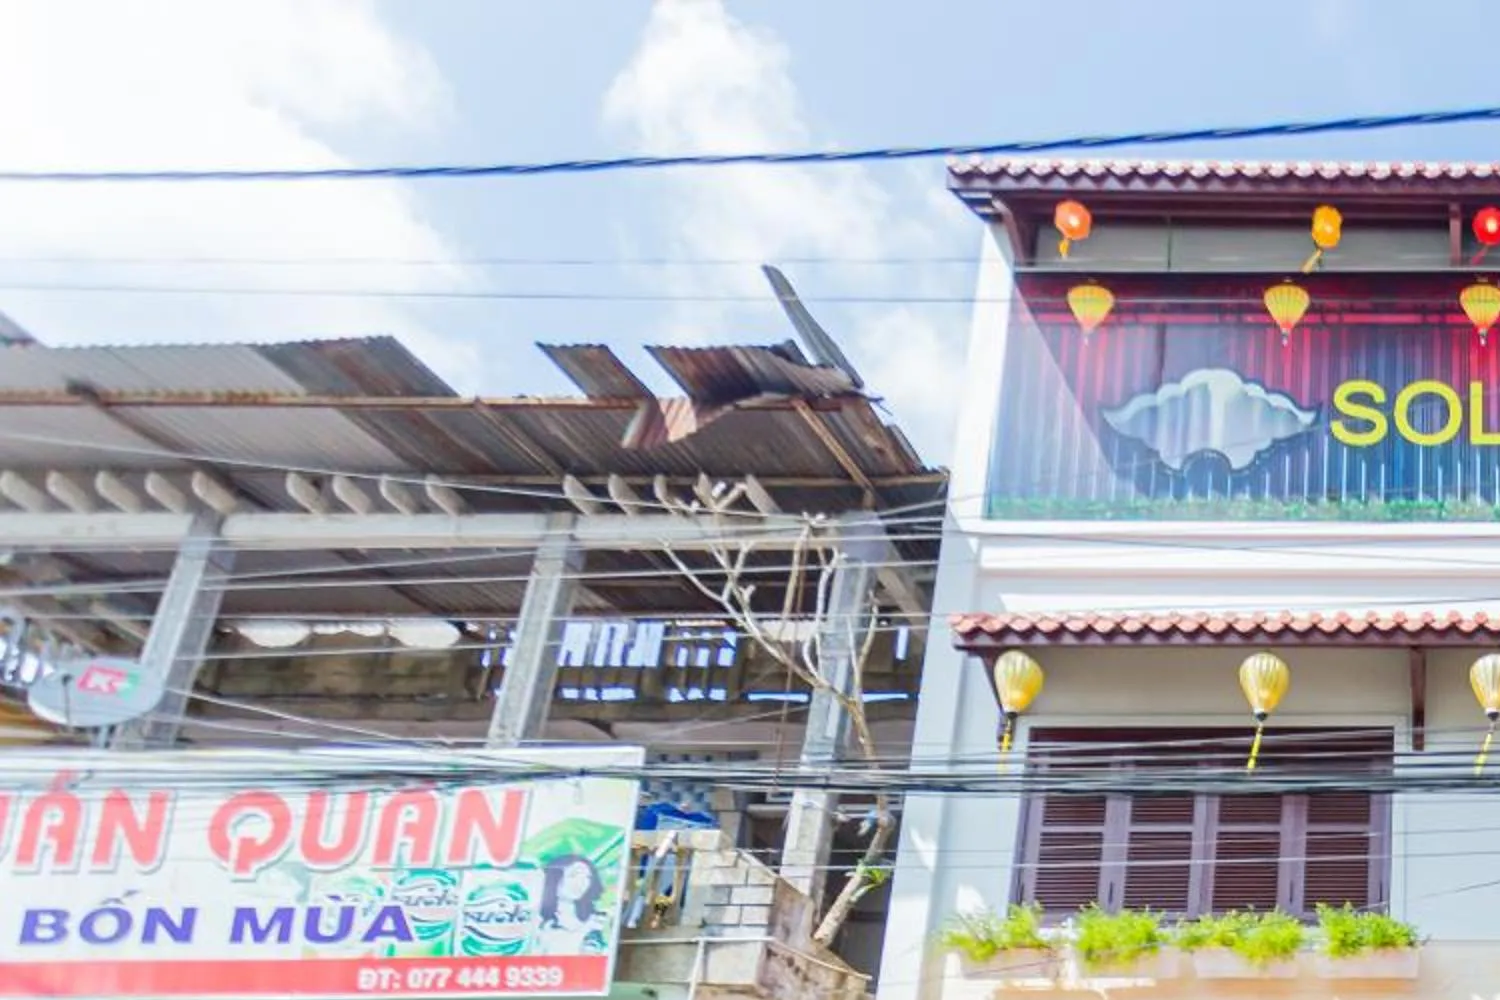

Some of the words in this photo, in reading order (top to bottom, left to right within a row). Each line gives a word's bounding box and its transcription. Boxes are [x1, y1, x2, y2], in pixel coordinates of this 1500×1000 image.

[0, 769, 172, 869] ÁN
[19, 889, 199, 945] BỐN
[229, 894, 414, 945] MÙA
[357, 968, 401, 991] ĐT:
[407, 967, 450, 990] 077
[456, 966, 499, 989] 444
[504, 965, 564, 988] 9339
